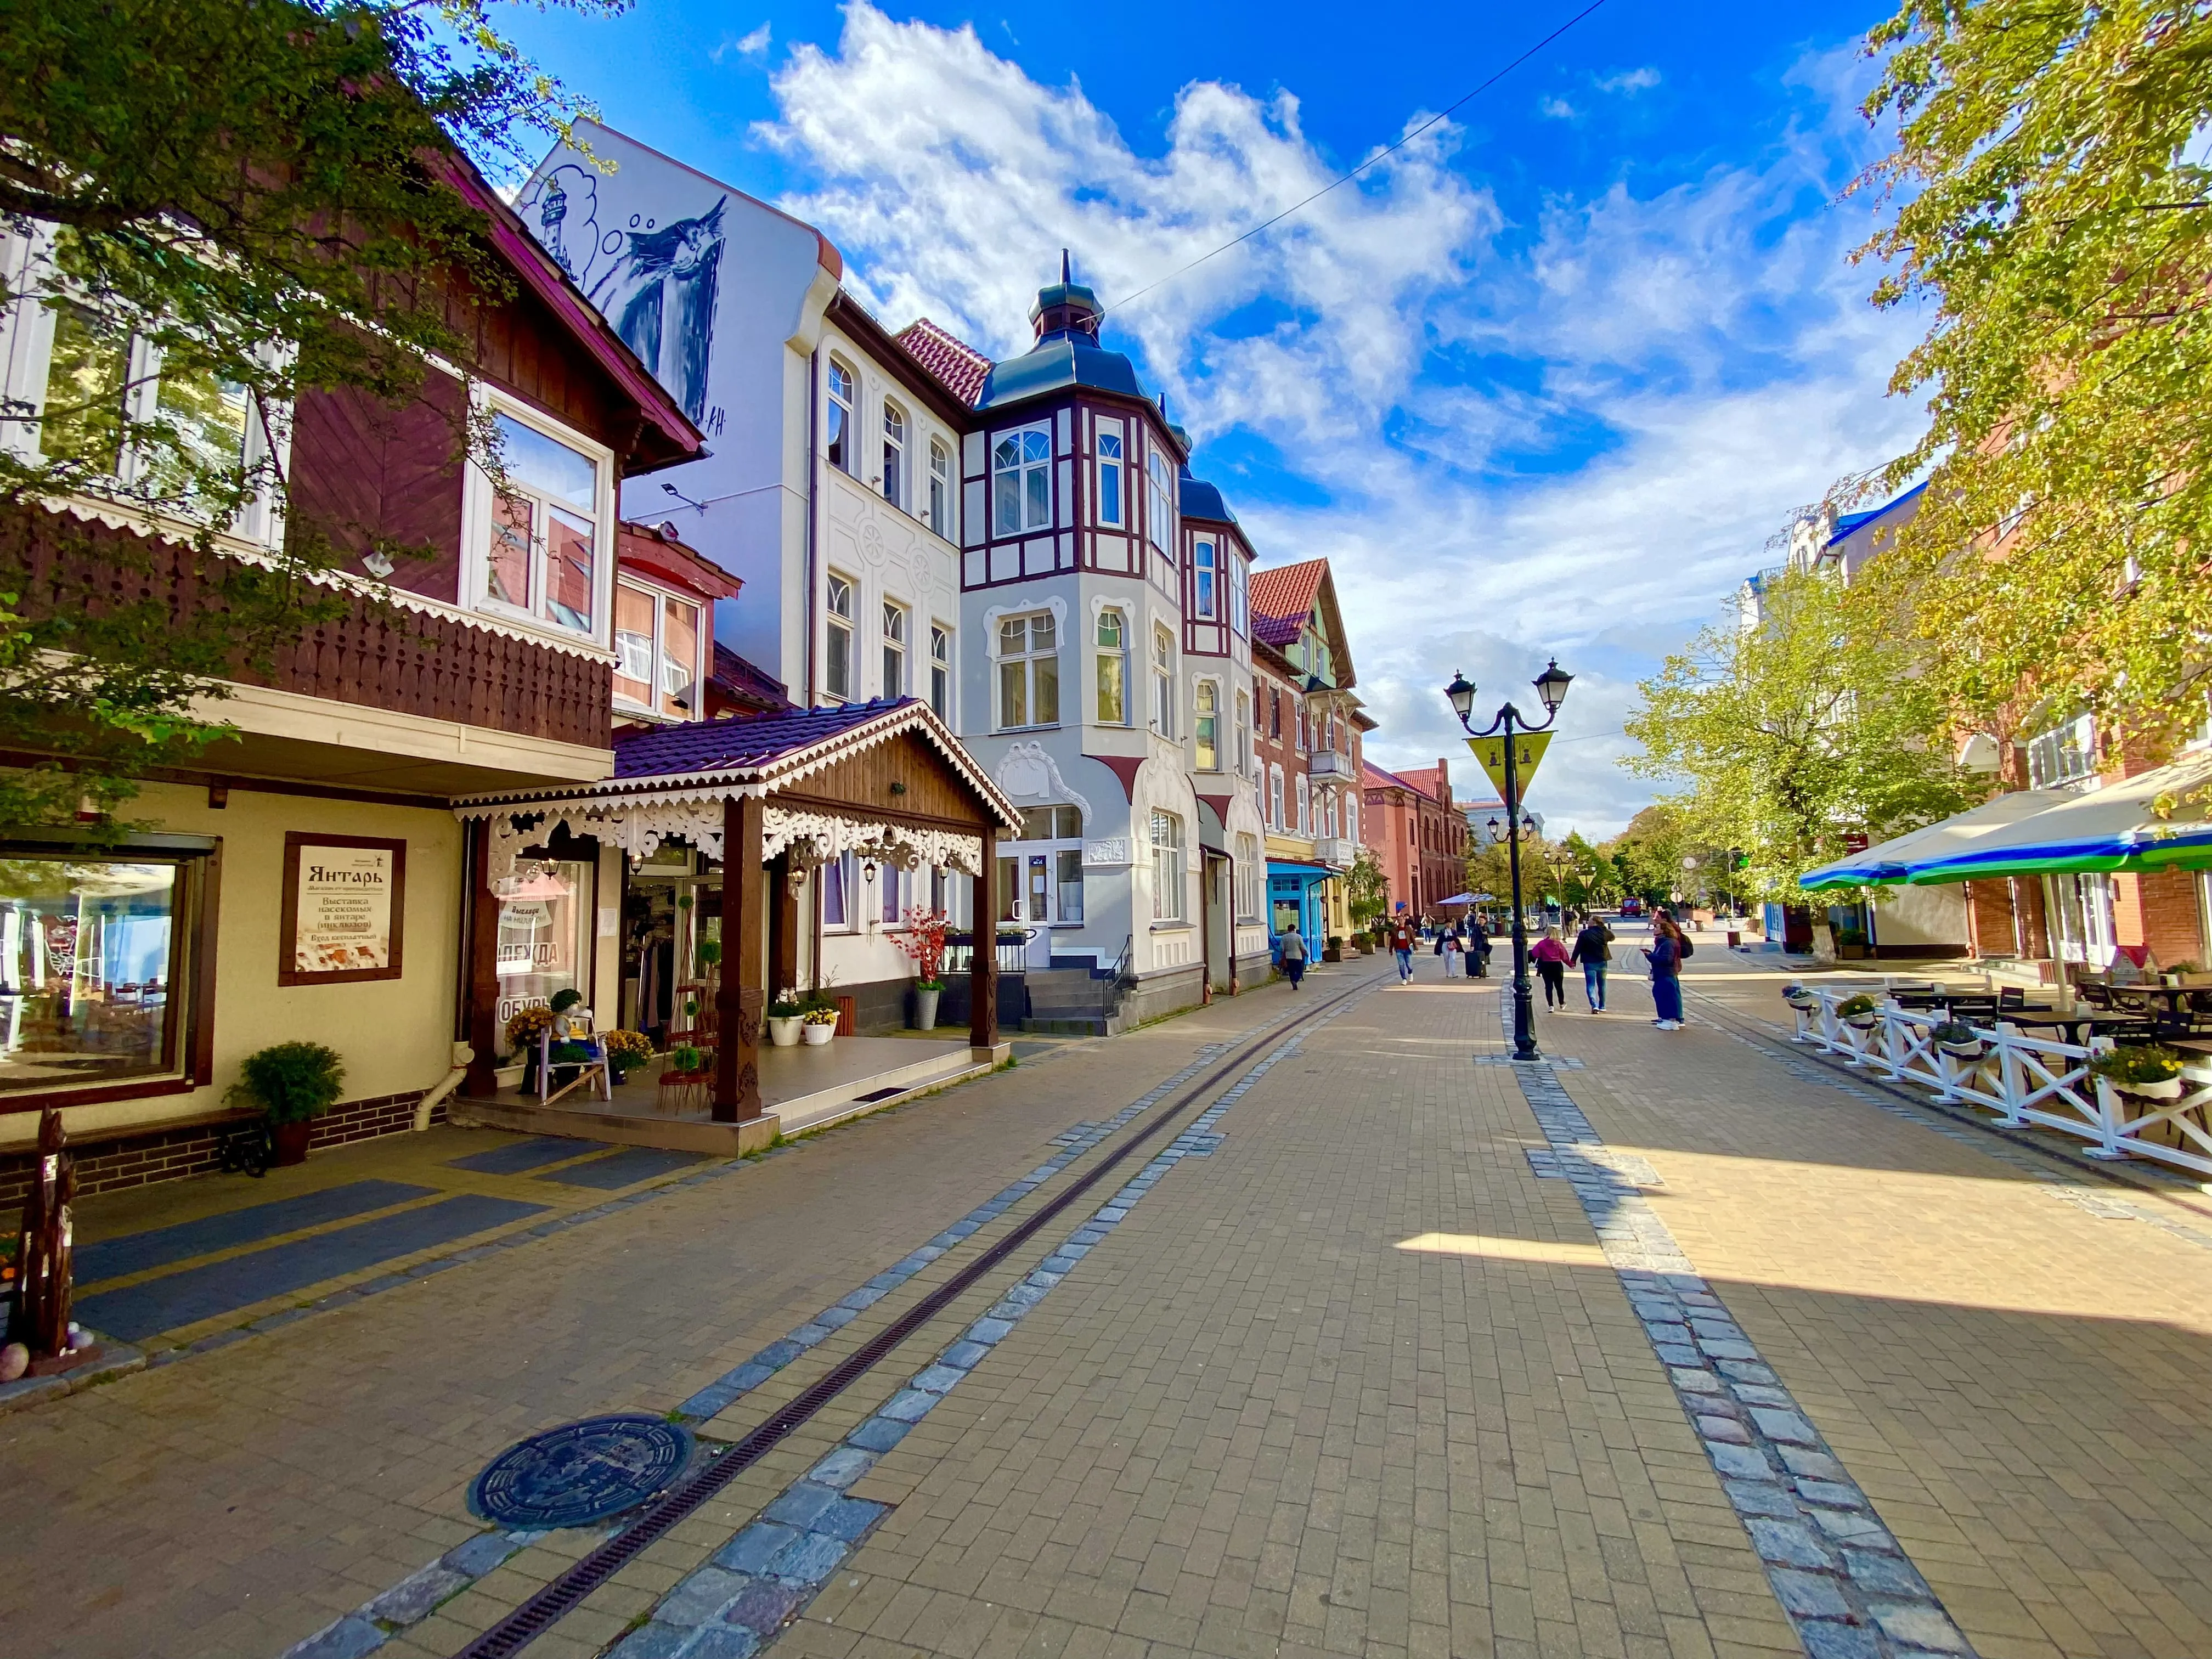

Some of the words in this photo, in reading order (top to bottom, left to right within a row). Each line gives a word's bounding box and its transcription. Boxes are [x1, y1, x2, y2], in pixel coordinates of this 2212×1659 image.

[308, 866, 383, 887] Янтарь
[322, 896, 369, 905] Выставка
[498, 944, 558, 965] ДЕЖДА
